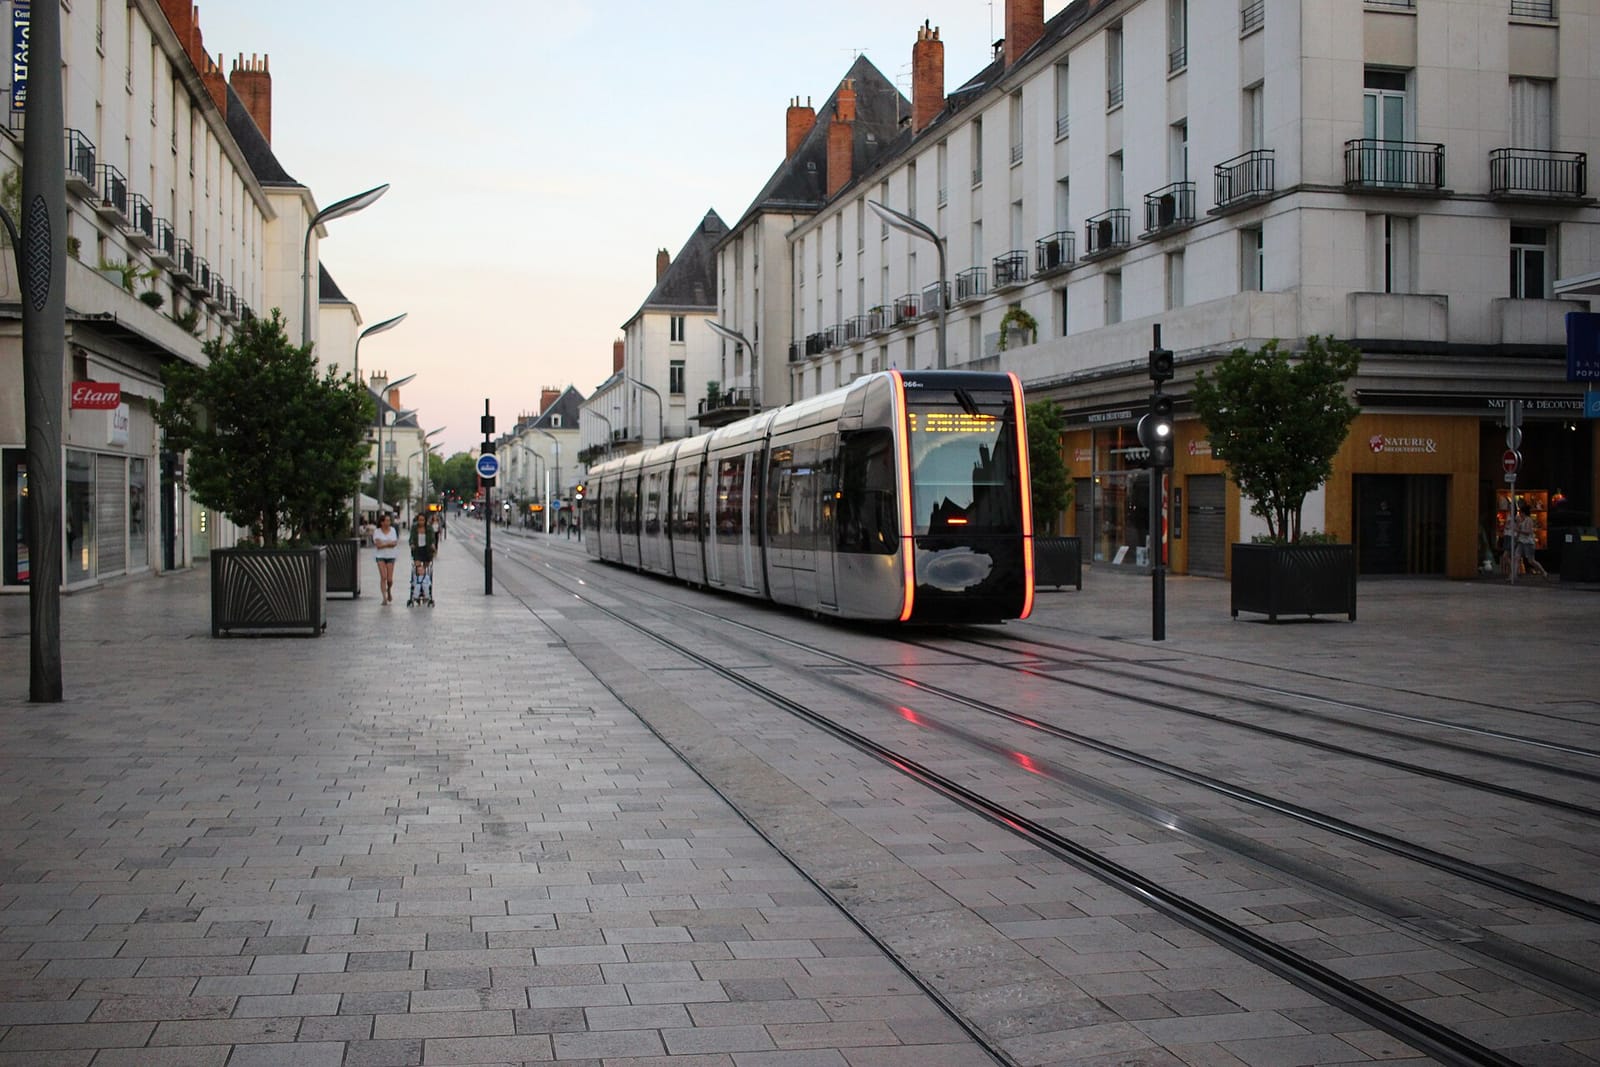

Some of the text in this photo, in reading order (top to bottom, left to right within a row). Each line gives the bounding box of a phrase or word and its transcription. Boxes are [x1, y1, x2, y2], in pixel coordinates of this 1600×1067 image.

[73, 387, 118, 401] Etam
[1488, 400, 1524, 408] NATE
[1385, 438, 1437, 452] NATURE &
